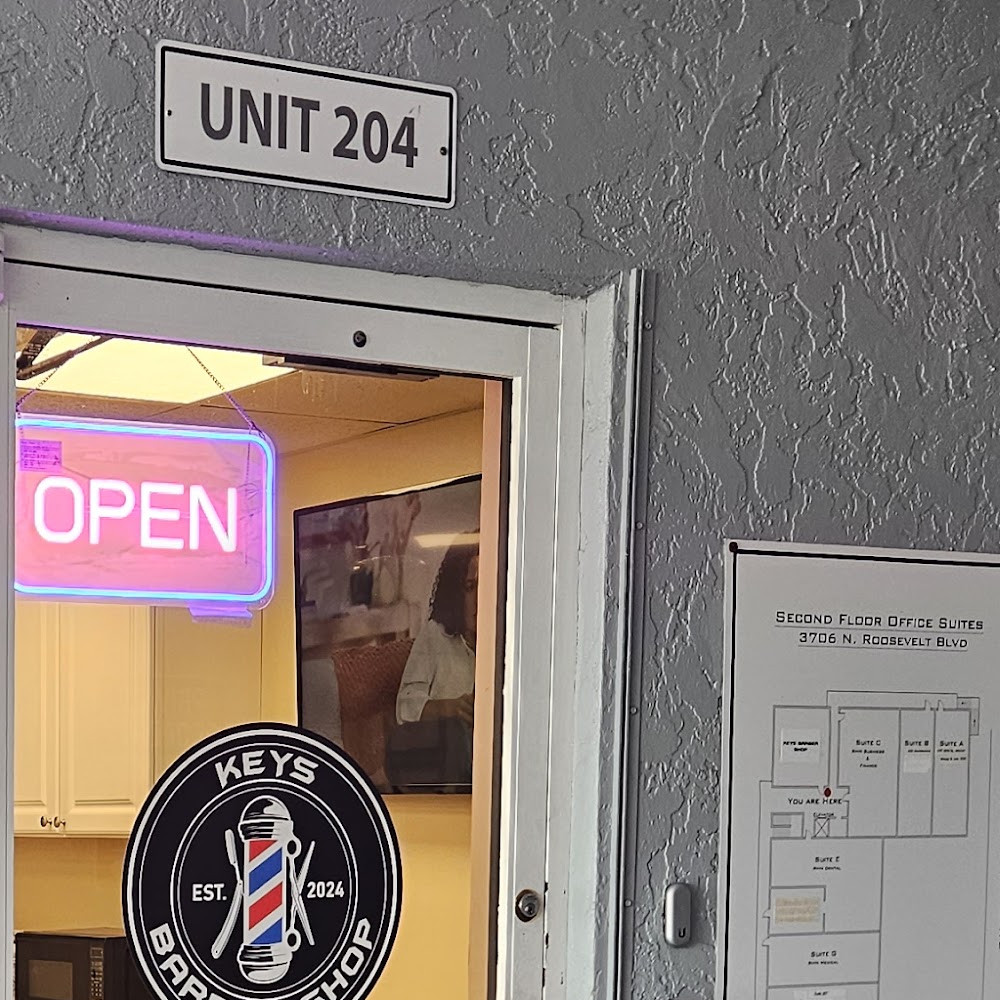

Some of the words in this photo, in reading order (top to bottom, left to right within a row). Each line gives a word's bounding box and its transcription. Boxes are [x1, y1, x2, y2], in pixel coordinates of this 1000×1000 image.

[200, 82, 320, 153] UNIT
[332, 105, 418, 168] 204
[33, 476, 238, 553] OPEN
[776, 611, 833, 625] SECOND
[839, 614, 882, 627] FLOOR
[888, 616, 933, 629] OFFICE
[938, 618, 984, 630] SUITES
[799, 632, 837, 644] 3706
[862, 634, 932, 647] ROOSEVELT
[936, 637, 968, 648] BLVD
[214, 749, 319, 790] KEYS
[192, 883, 227, 902] EST.
[307, 881, 345, 899] 2024
